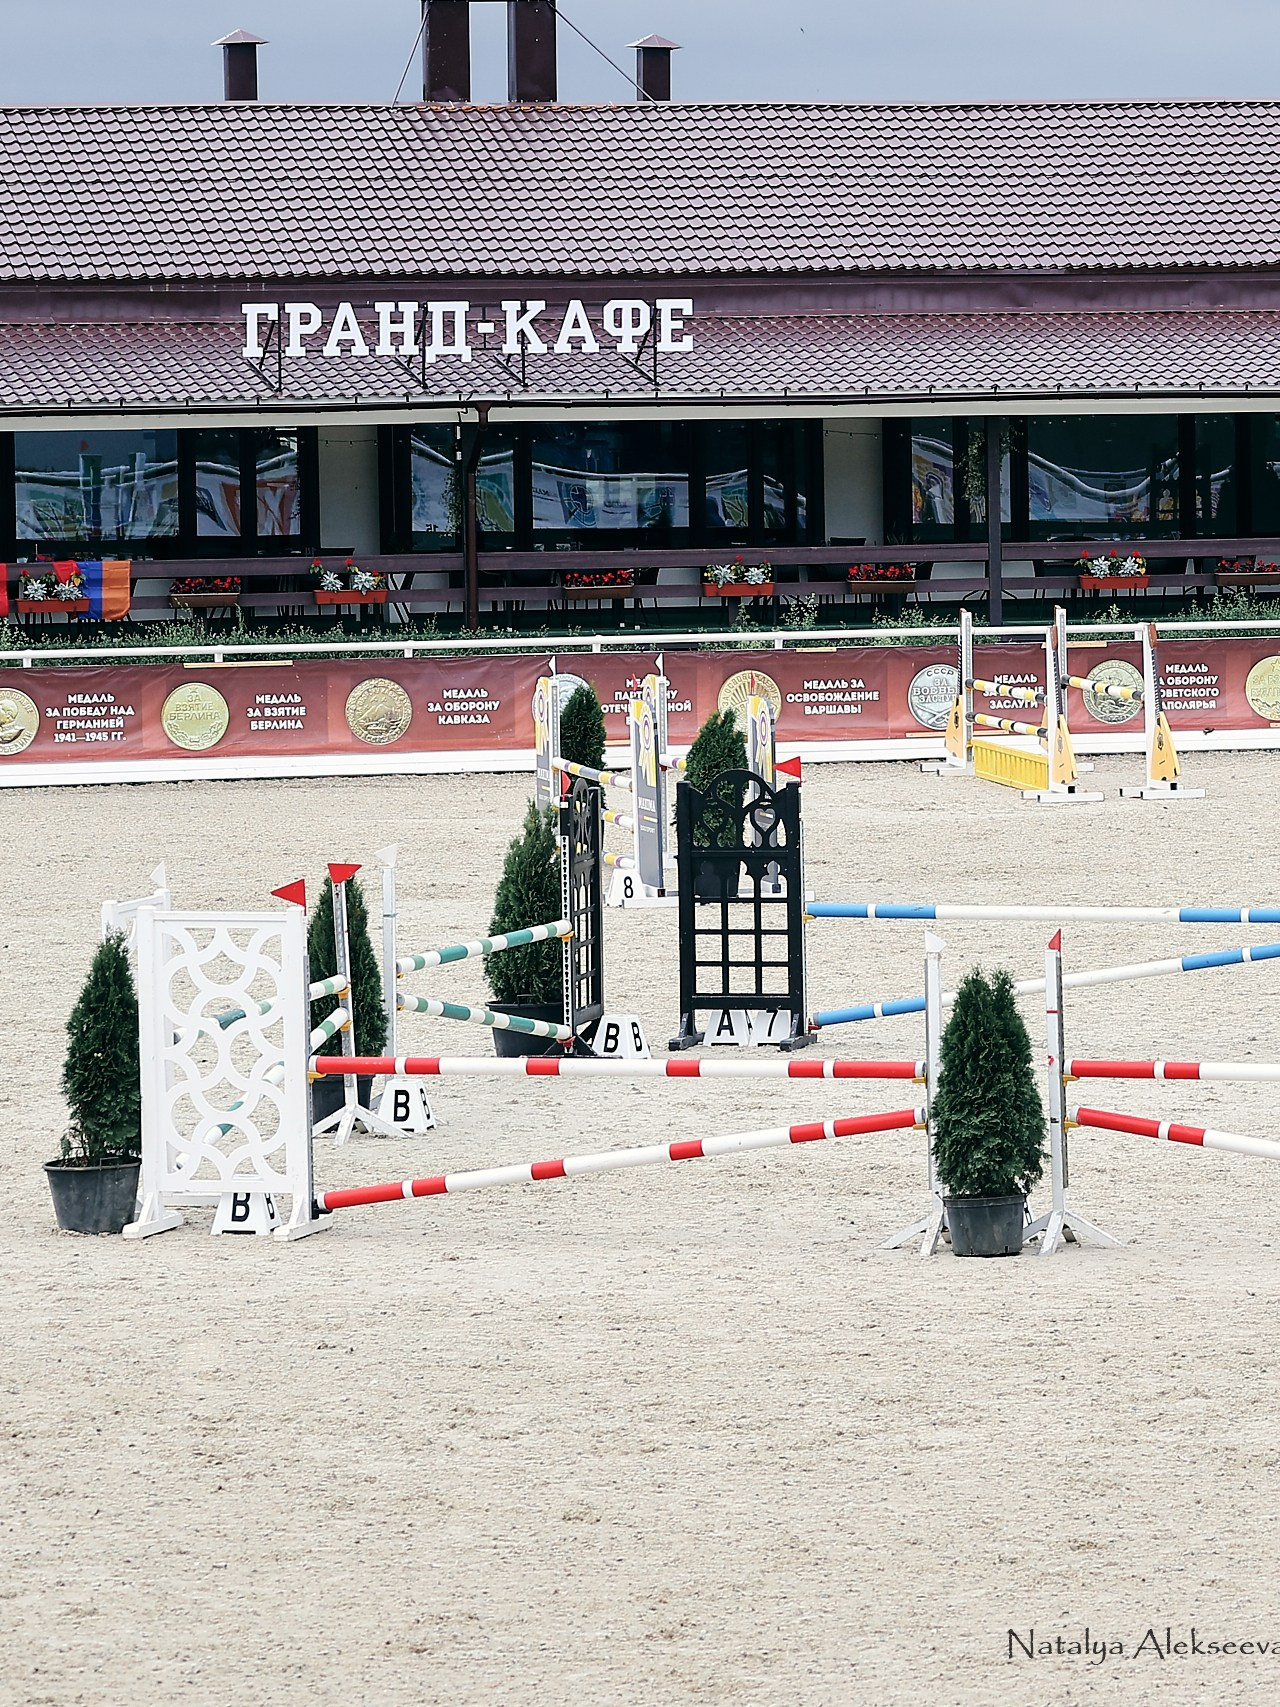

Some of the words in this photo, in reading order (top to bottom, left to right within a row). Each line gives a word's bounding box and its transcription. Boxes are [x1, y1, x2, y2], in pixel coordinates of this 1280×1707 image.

[241, 299, 694, 362] ГРАНД-КАФЕ
[926, 668, 954, 677] СССР
[1165, 663, 1209, 674] МЕДАЛЬ
[803, 679, 849, 690] МЕДАЛЬ
[850, 678, 865, 689] ЗА
[994, 674, 1038, 684] МЕДАЛЬ
[1168, 675, 1219, 686] ОБОРОНУ
[443, 688, 488, 699] МЕДАЛЬ
[614, 690, 678, 701] ПАРТНУ
[913, 686, 957, 696] БОЕВЫ
[1161, 687, 1219, 698] ОВЕТСКОГО
[68, 693, 115, 704] МЕДАЛЬ
[255, 693, 302, 705] МЕДАЛЬ
[786, 691, 880, 703] ОСВОБОЖДЕНИЕ
[919, 694, 956, 703] ЗАСЛУГ
[175, 703, 213, 712] ВЗЯТИЕ
[427, 702, 443, 712] ЗА
[444, 700, 500, 712] ОБОРОНУ
[804, 704, 862, 715] ВАРШАВЫ
[990, 700, 1038, 709] ЗАСЛУГИ
[1162, 700, 1216, 710] АПОЛЯРЬЯ
[45, 707, 61, 717] ЗА
[62, 706, 108, 717] ПОБЕДУ
[110, 705, 135, 716] НАД
[169, 712, 221, 721] БЕРЛИНА
[246, 707, 262, 718] ЗА
[264, 706, 306, 717] ВЗЯТИЕ
[56, 716, 124, 730] ГЕРМАНИЕЙ
[250, 719, 304, 731] БЕРЛИНА
[438, 714, 491, 725] КАВКАЗА
[111, 731, 127, 741] ГГ.
[623, 876, 634, 899] 8
[766, 1009, 778, 1037] 7
[604, 1022, 620, 1053] B
[632, 1021, 643, 1051] B
[393, 1089, 410, 1122] B
[231, 1192, 251, 1222] B
